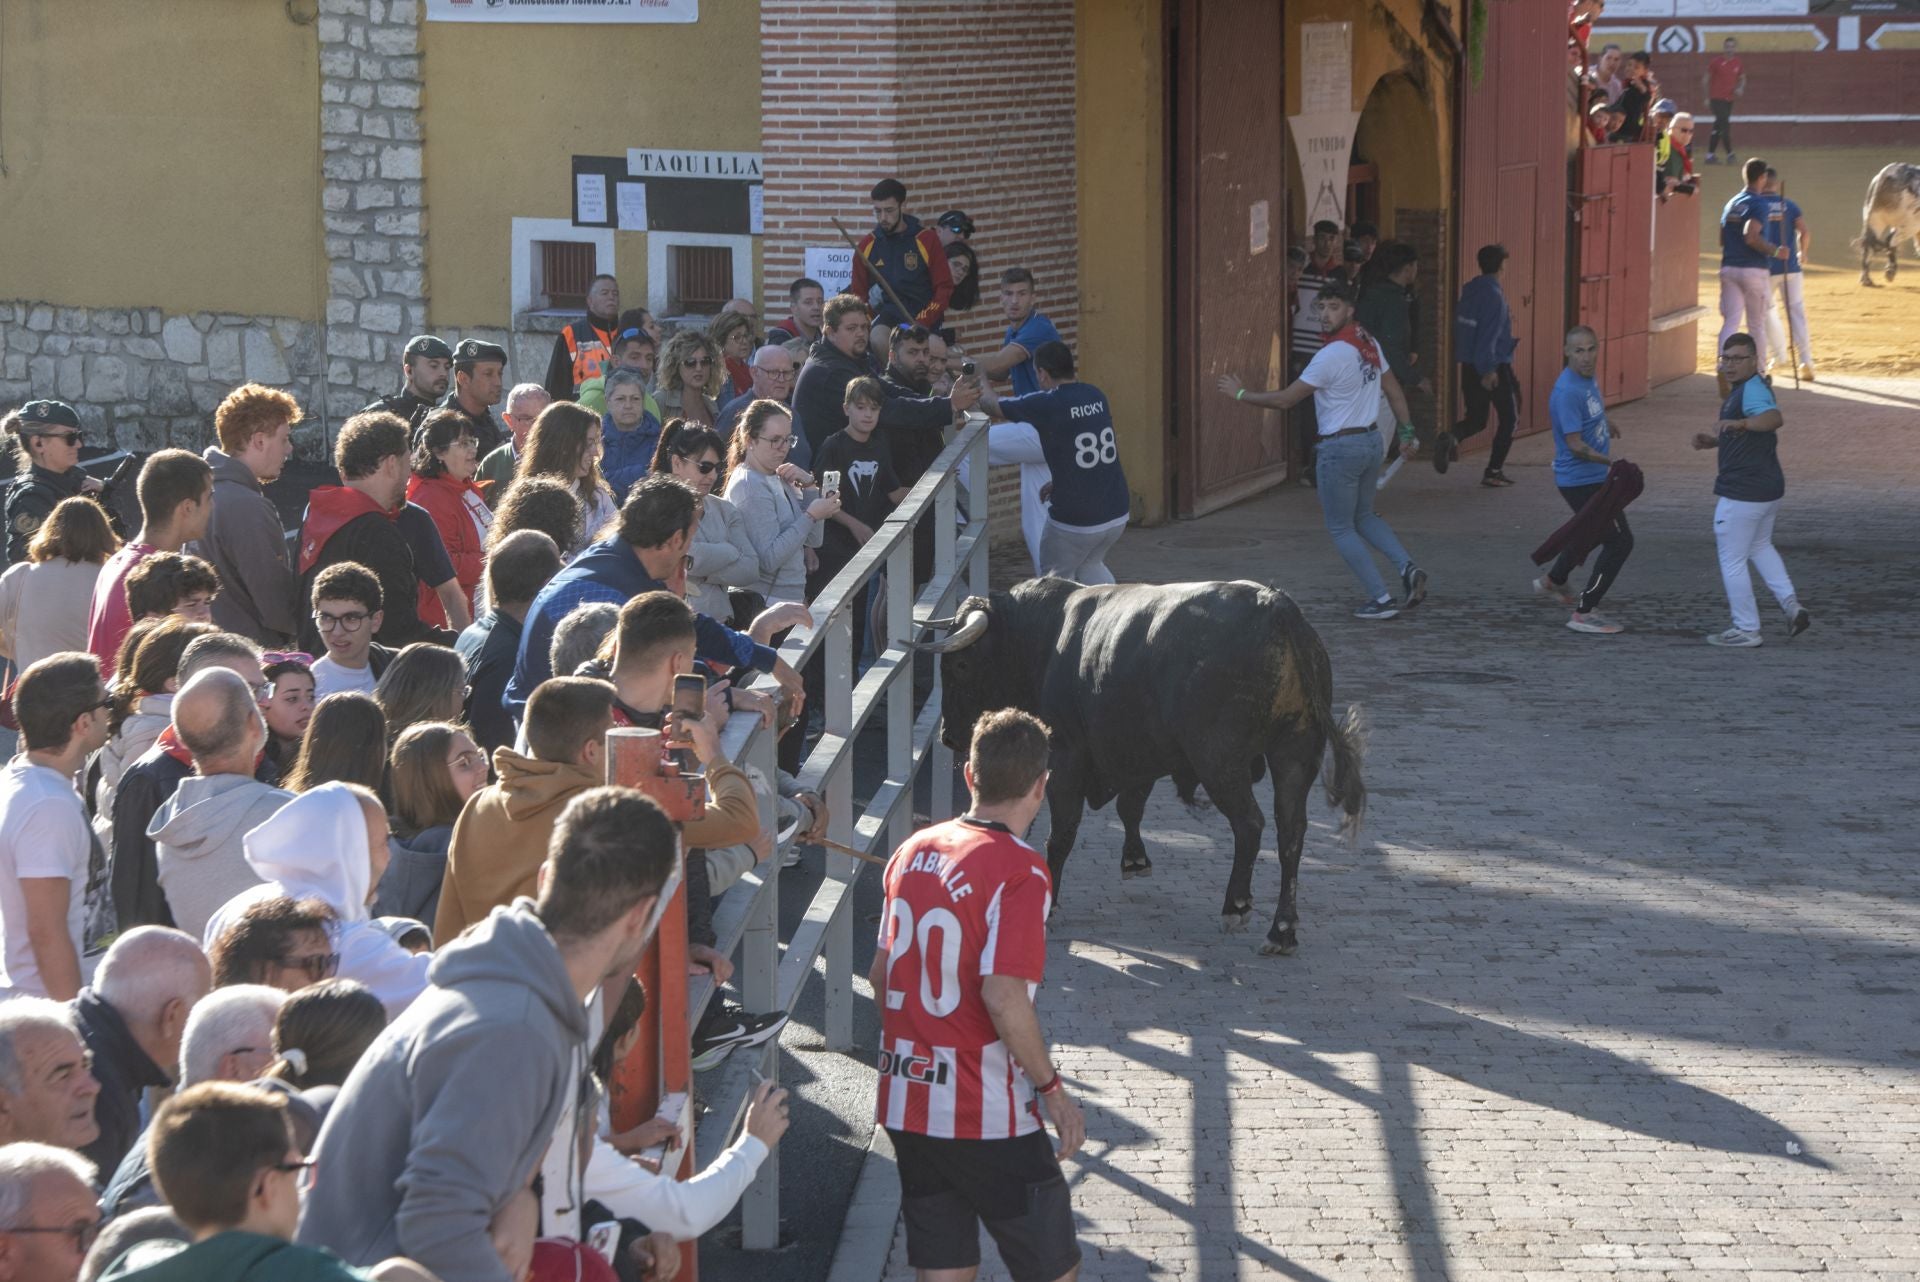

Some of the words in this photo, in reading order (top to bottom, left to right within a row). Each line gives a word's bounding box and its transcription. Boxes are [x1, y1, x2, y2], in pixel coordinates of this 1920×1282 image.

[1308, 136, 1346, 153] TENDIDO
[827, 254, 850, 263] SOLO
[1070, 401, 1104, 420] RICKY
[1075, 426, 1117, 469] 88
[886, 897, 962, 1018] 20
[879, 1048, 949, 1087] DIGI
